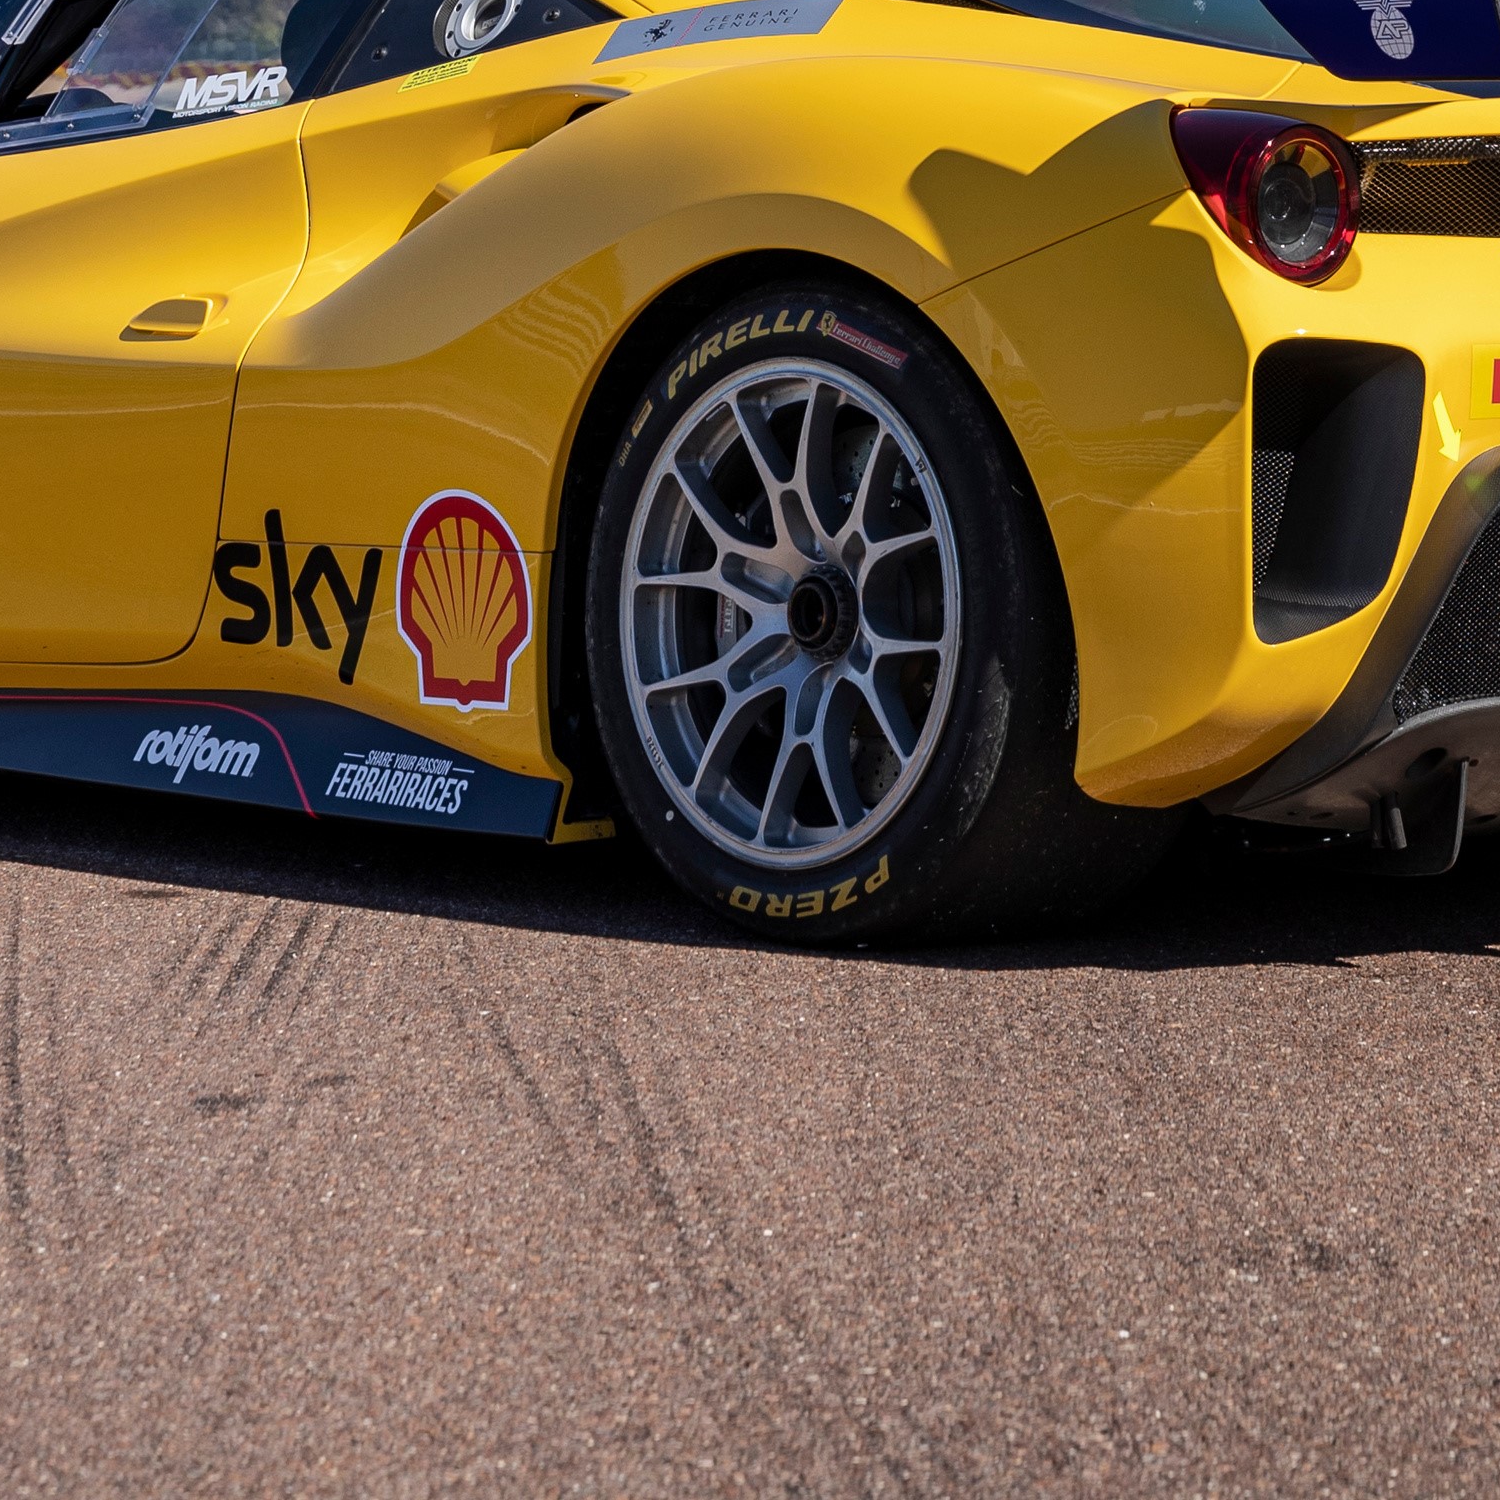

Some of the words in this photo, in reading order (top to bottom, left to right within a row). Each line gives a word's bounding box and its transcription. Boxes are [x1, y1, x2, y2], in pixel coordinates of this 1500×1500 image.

[703, 16, 794, 32] GENUINE
[708, 8, 799, 23] FERRARI
[172, 105, 224, 119] MOTORSPORT
[224, 102, 249, 112] VISION
[250, 98, 279, 108] RACING
[175, 66, 288, 111] MSVR
[668, 309, 815, 400] PIRELLI
[213, 509, 383, 685] sky
[133, 724, 260, 784] rotiform
[365, 750, 394, 767] SHARE
[393, 753, 418, 771] YOUR
[417, 757, 453, 776] PASSION
[325, 762, 469, 815] FERRARIRACES
